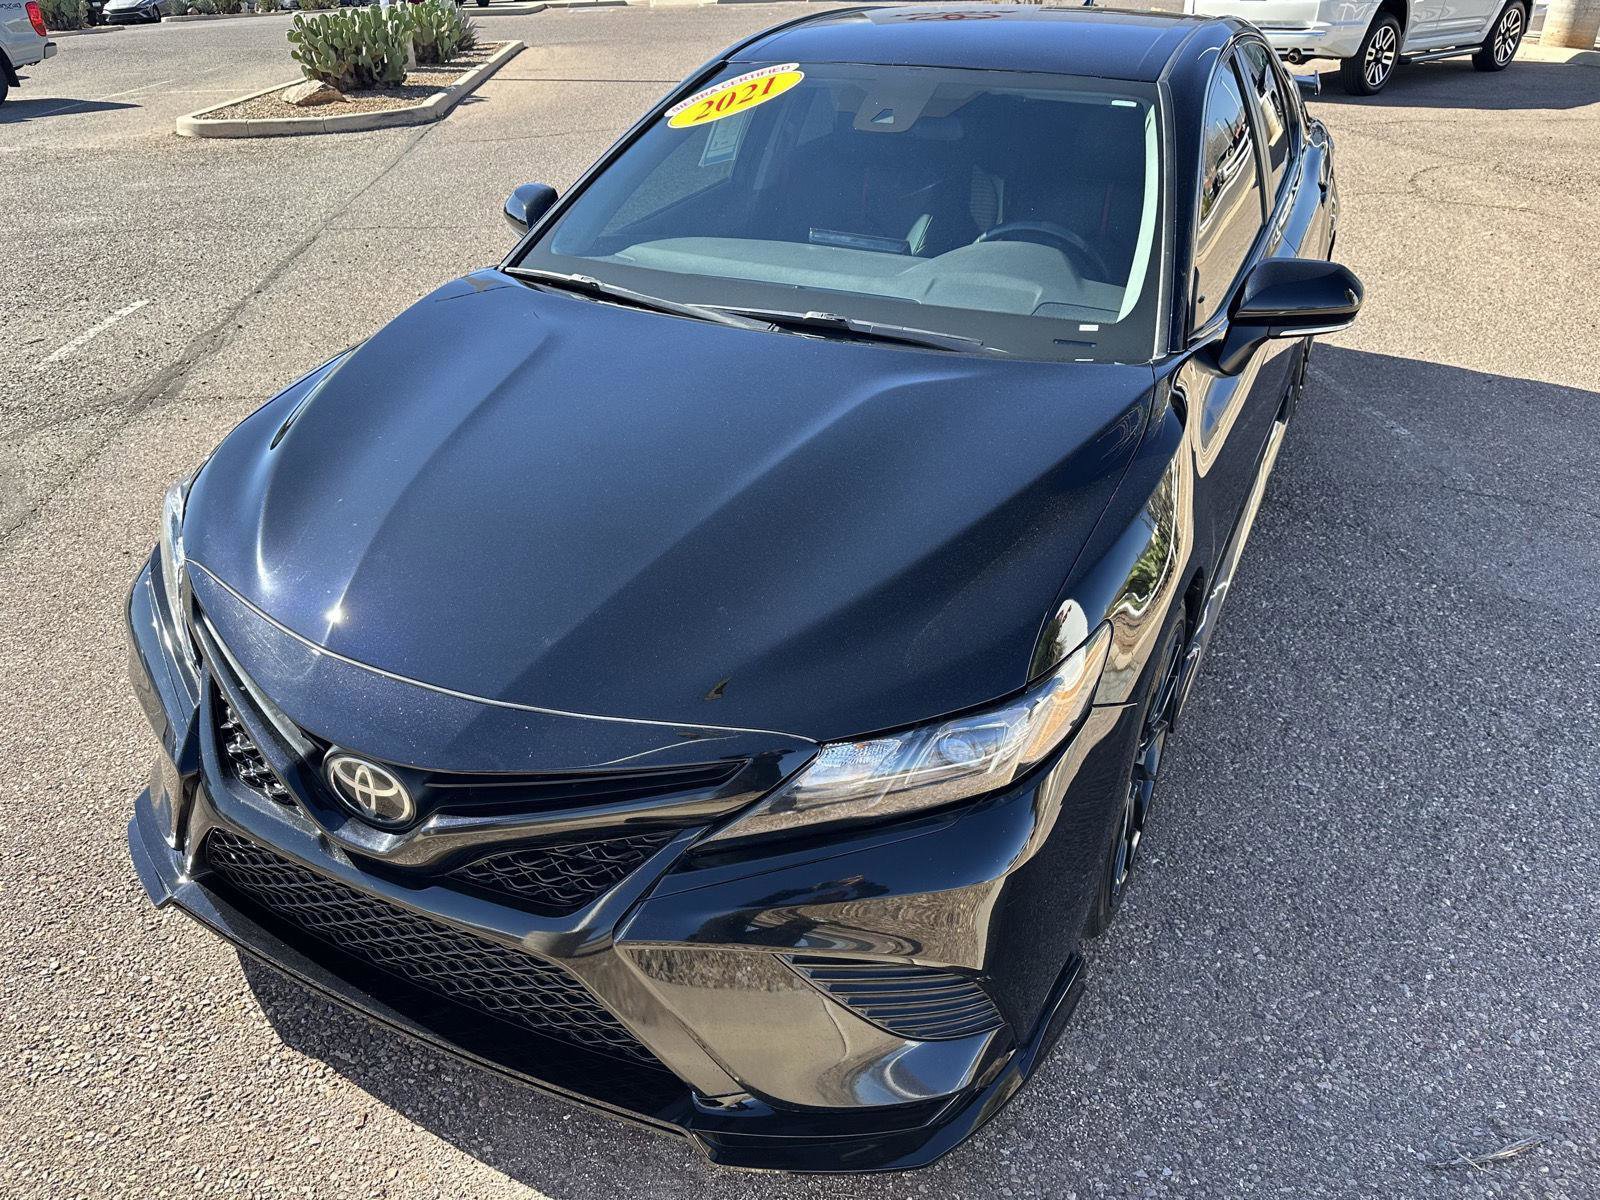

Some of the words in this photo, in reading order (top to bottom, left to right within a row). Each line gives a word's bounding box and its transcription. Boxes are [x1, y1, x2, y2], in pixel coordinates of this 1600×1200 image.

[671, 88, 719, 112] SIERRA
[721, 65, 791, 89] CERTIFIED
[692, 76, 776, 122] 2021
